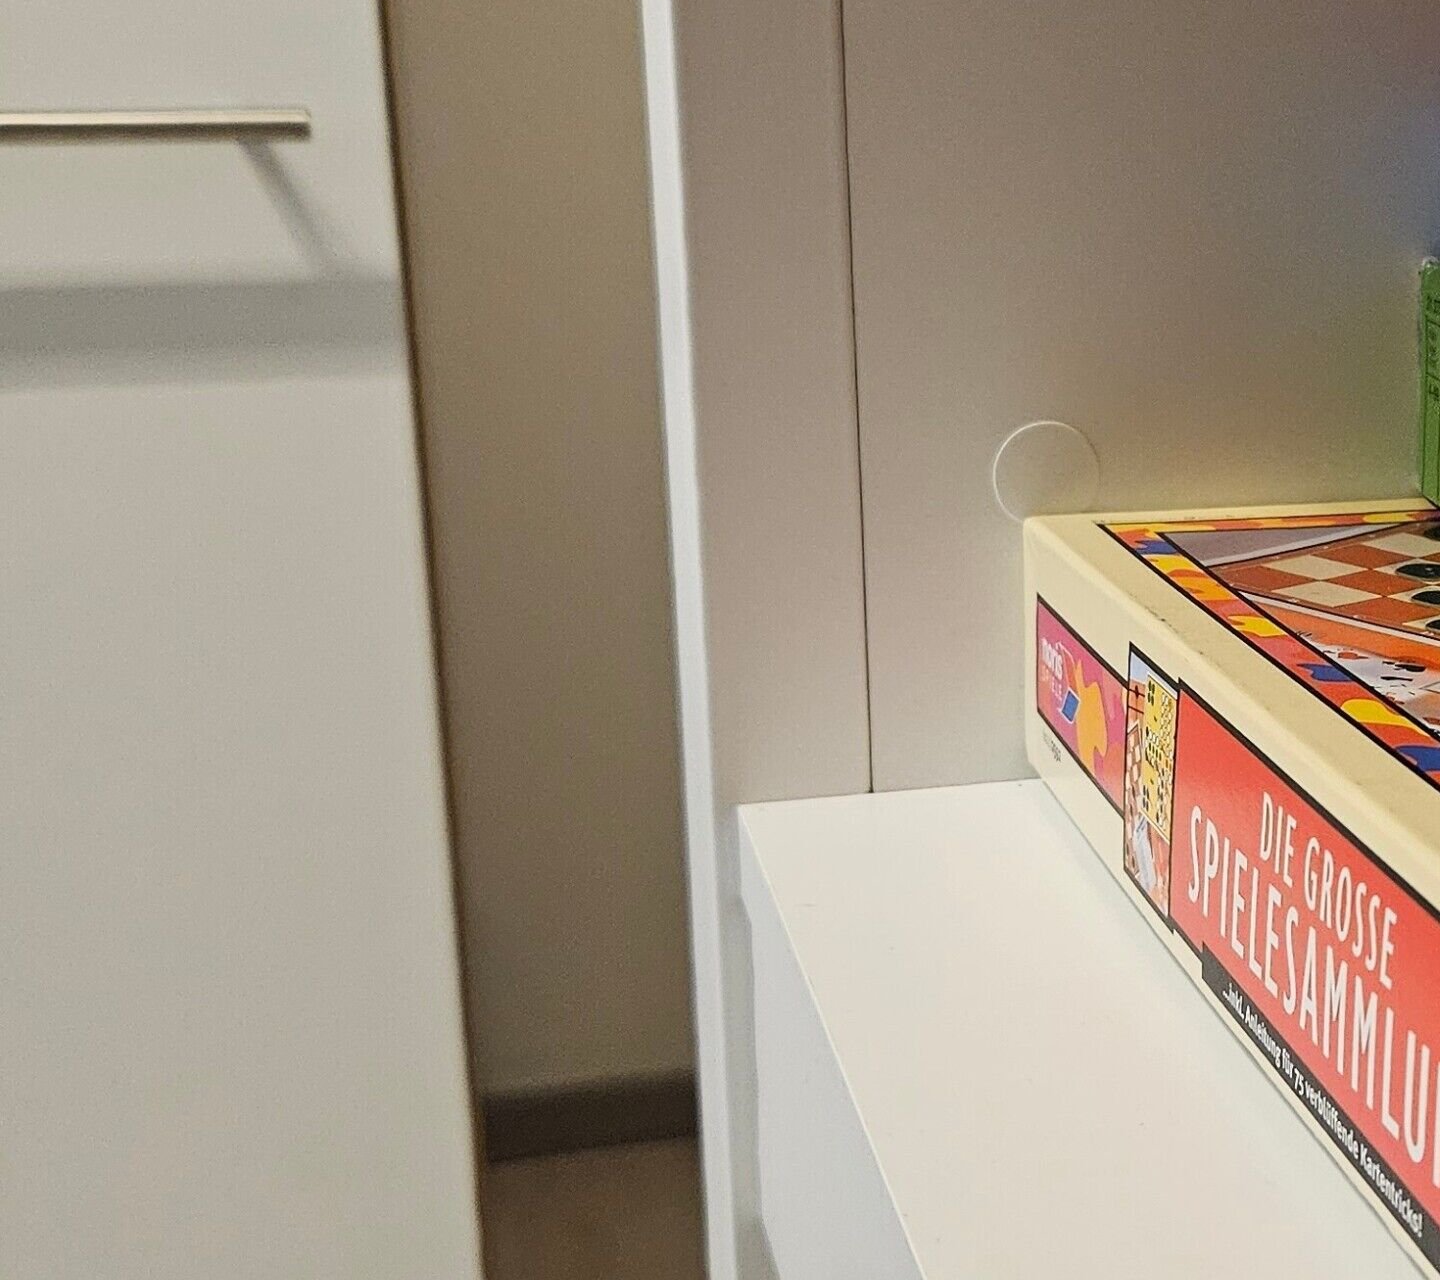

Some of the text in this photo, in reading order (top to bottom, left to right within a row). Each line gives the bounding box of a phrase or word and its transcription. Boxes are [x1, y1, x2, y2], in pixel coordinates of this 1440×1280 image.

[1259, 790, 1398, 991] DIE GROSSE
[1244, 1005, 1282, 1069] Anleitung
[1281, 1047, 1294, 1080] für
[1293, 1067, 1305, 1097] 75
[1304, 1080, 1359, 1161] verblüffende
[1360, 1143, 1424, 1239] Kartentricks!
